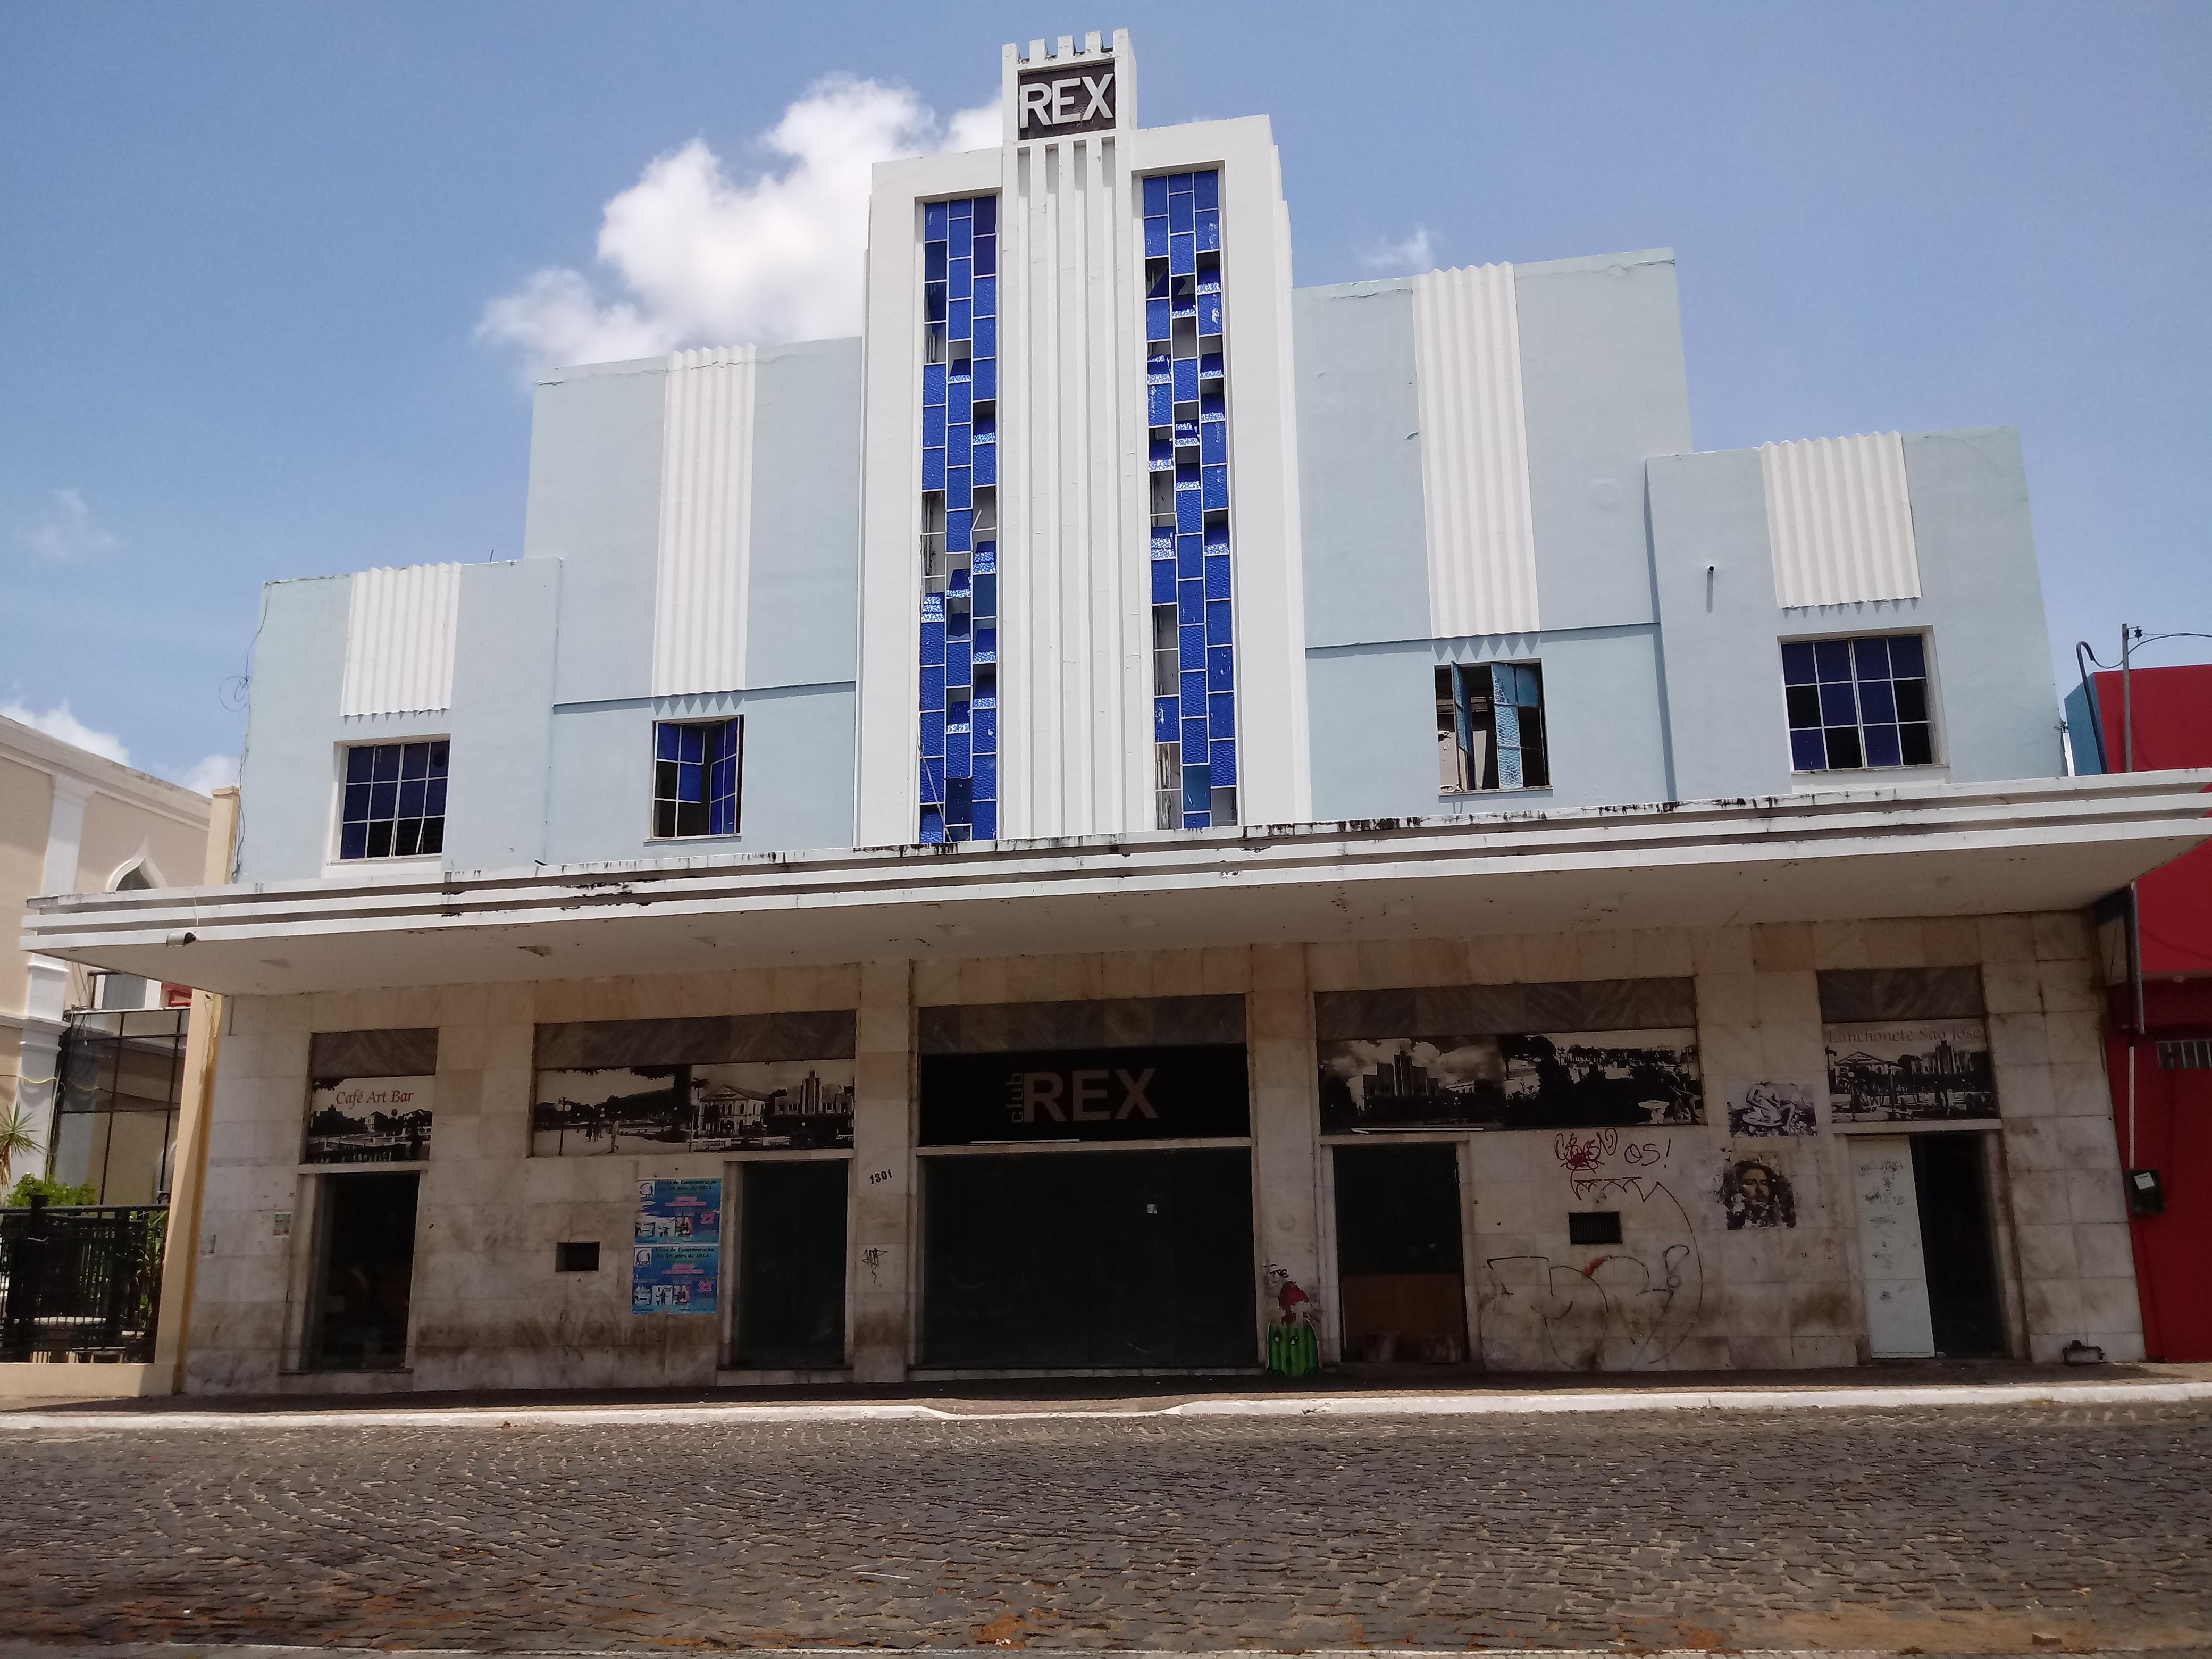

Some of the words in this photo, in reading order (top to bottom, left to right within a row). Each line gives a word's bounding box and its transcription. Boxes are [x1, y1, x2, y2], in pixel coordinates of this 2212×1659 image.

[1020, 73, 1114, 129] REX
[336, 1088, 364, 1110] Café
[366, 1091, 387, 1103] Art
[390, 1090, 414, 1103] Bar
[1005, 1072, 1024, 1123] club
[1023, 1068, 1159, 1123] REX
[869, 1169, 893, 1184] 1301
[700, 1212, 715, 1224] 22
[698, 1280, 713, 1292] 22
